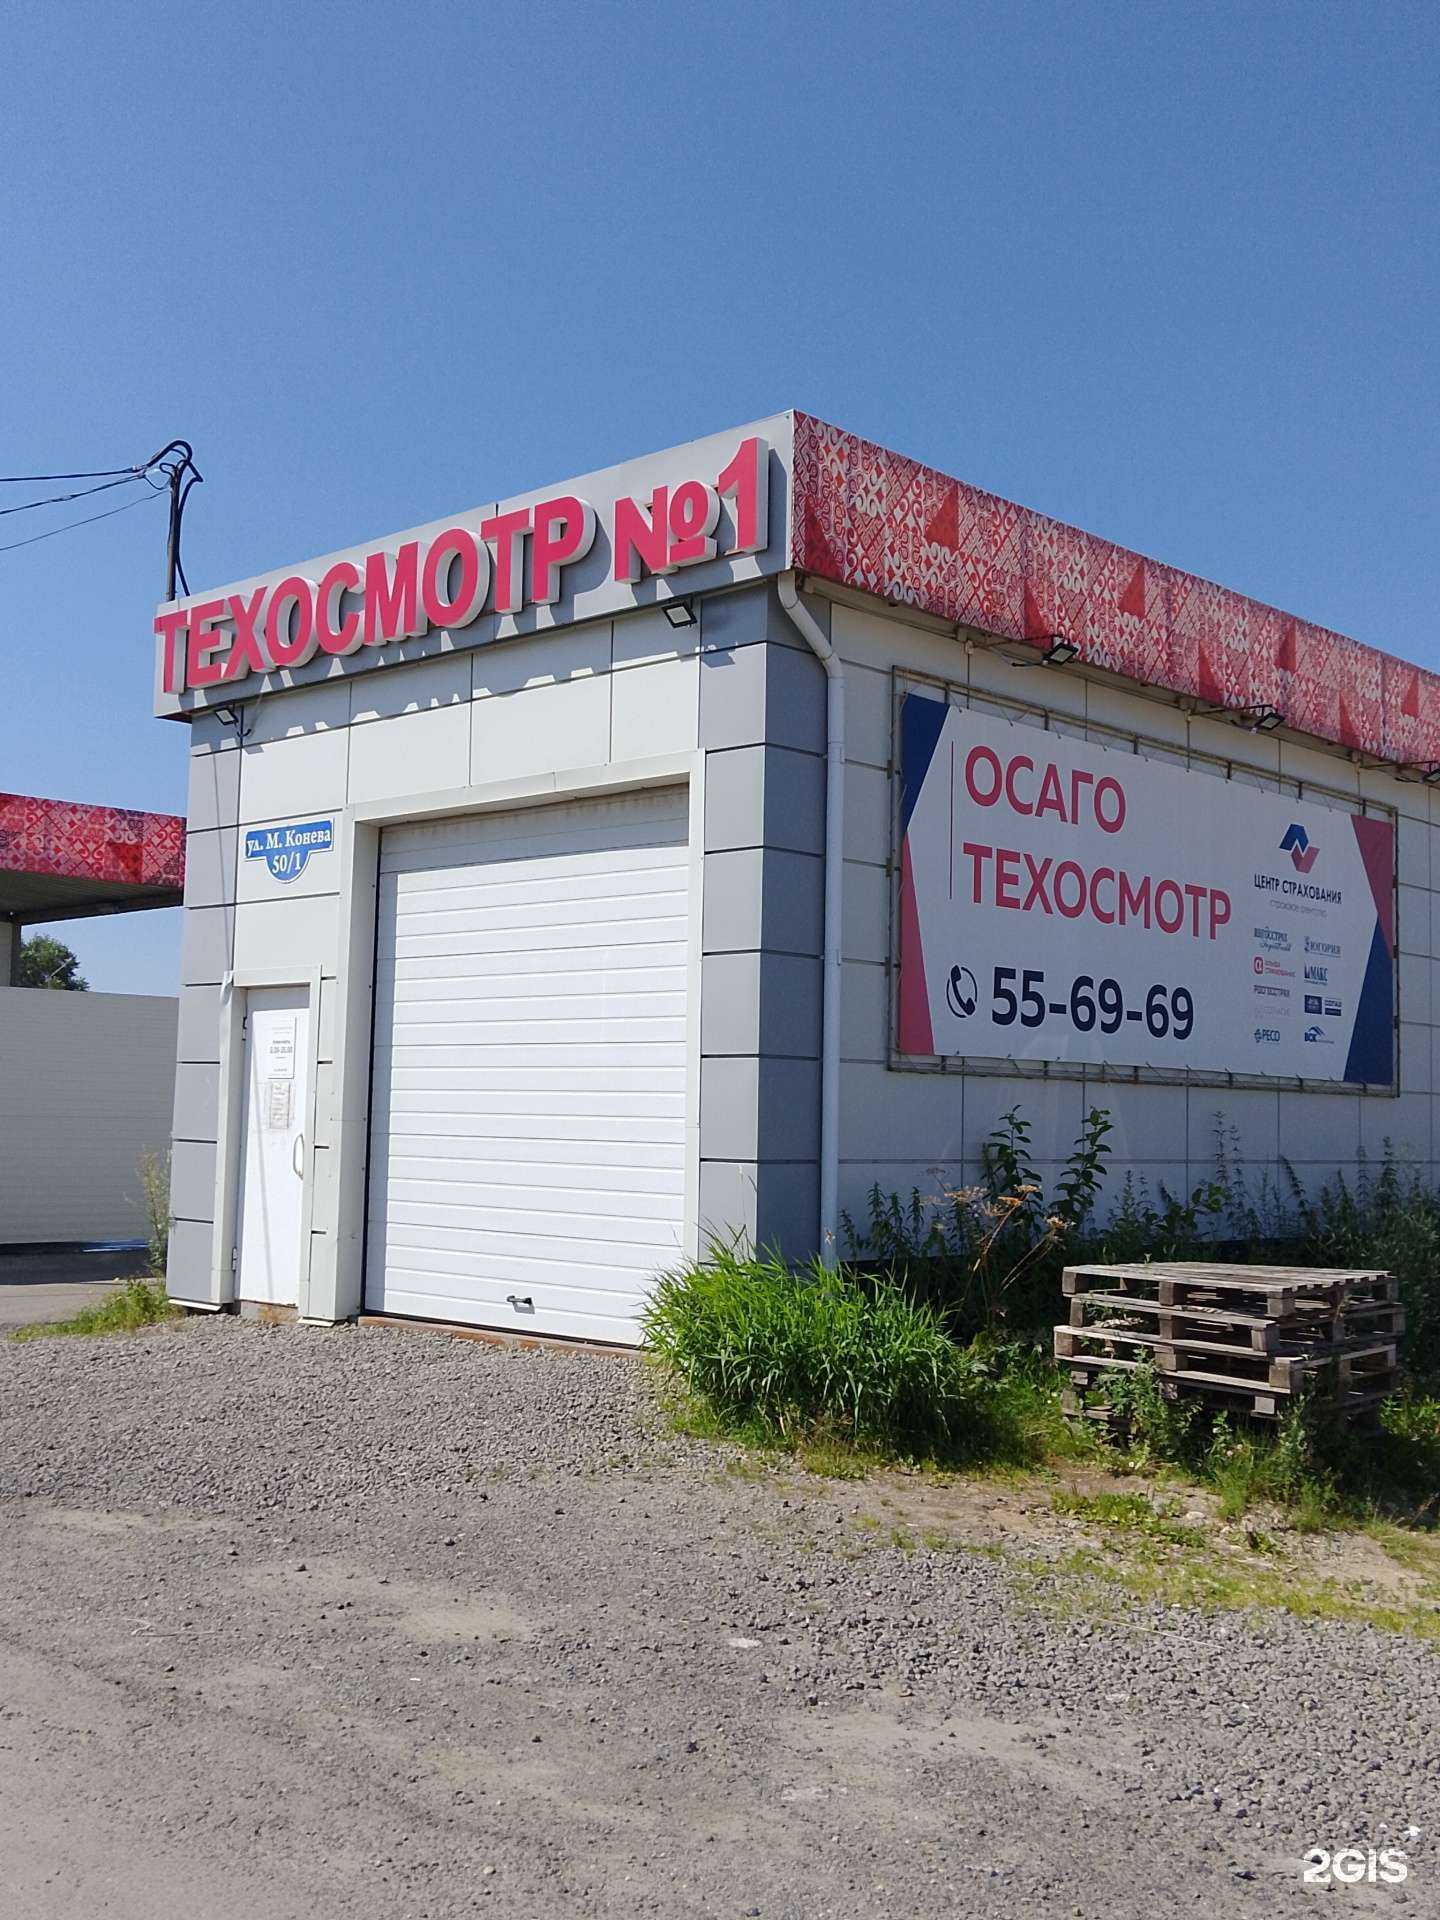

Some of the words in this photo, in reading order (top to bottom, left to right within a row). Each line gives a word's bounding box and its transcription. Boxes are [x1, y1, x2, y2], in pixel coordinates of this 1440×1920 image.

[153, 494, 596, 695] ТЕХОСМОТР
[613, 436, 769, 585] №1
[965, 745, 1127, 834] ОСАГО
[247, 839, 264, 857] ул.
[266, 832, 282, 850] М.
[285, 829, 331, 847] Конева
[271, 852, 302, 874] 50/1
[963, 842, 1232, 940] ТЕХОСМОТР
[1254, 873, 1280, 892] ЦЕНТР
[1282, 879, 1342, 905] СТРАХОВАНИЯ
[991, 966, 1195, 1041] 55-69-69
[1262, 1028, 1280, 1042] РЕСО
